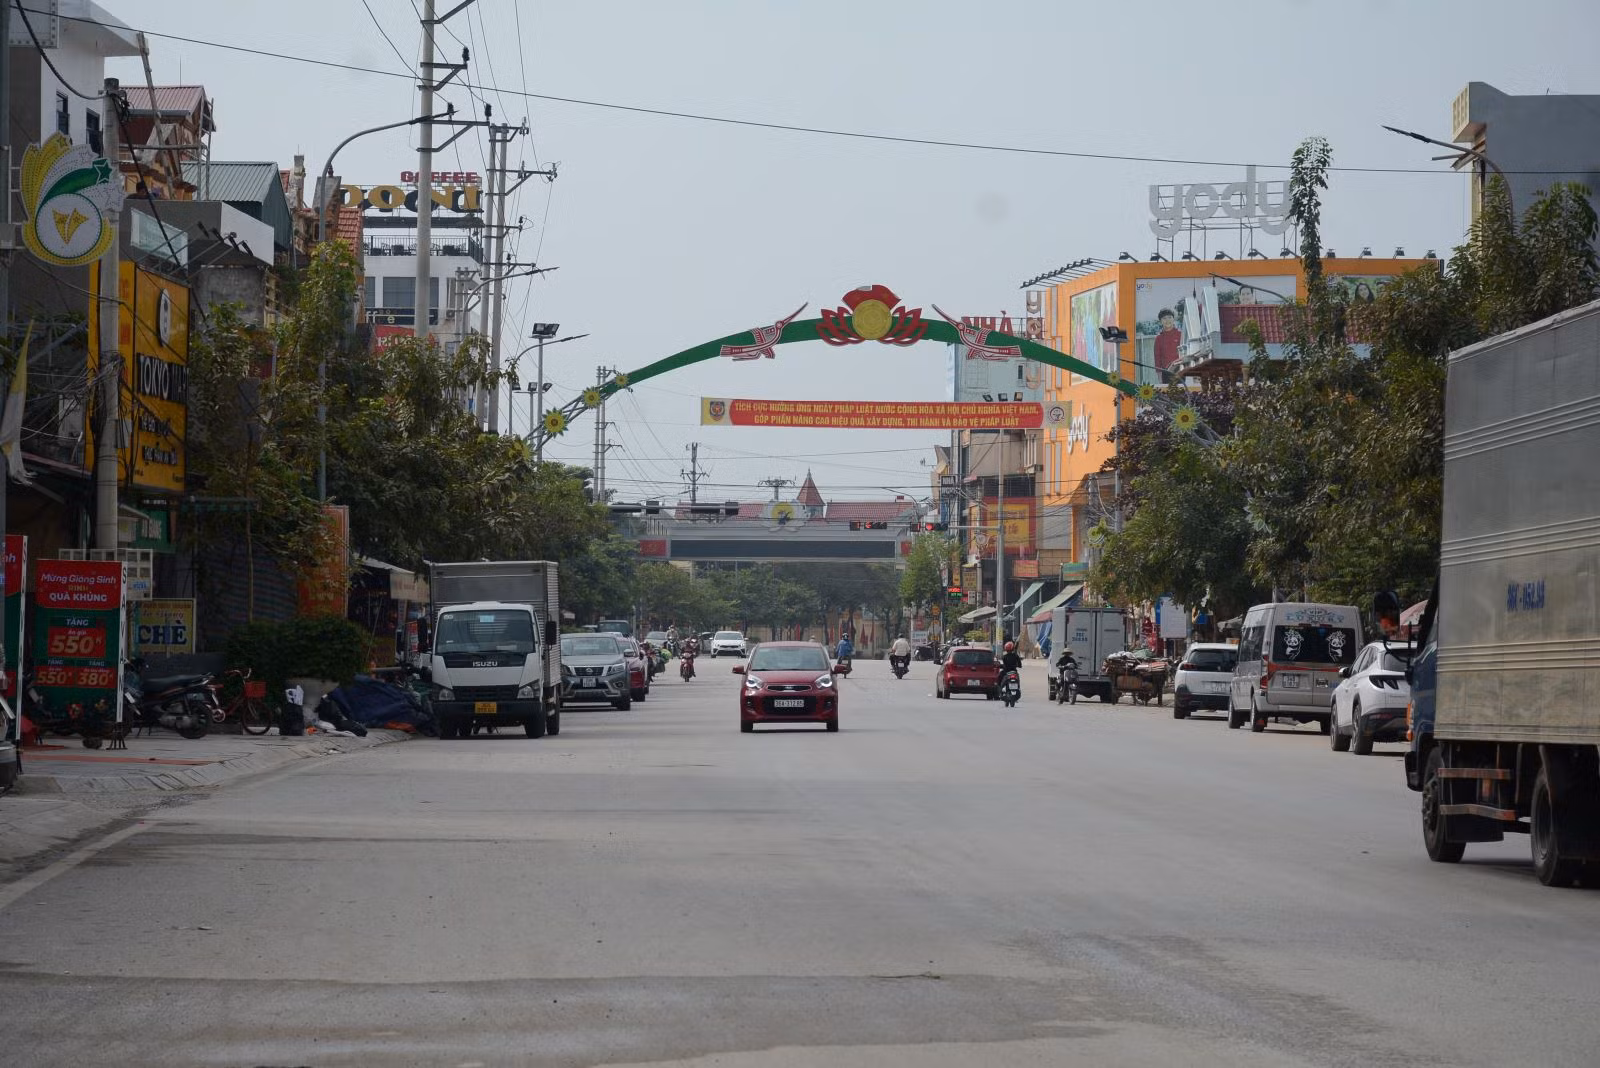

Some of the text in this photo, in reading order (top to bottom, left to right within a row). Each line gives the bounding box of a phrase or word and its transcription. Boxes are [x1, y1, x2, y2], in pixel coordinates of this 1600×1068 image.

[401, 171, 478, 182] CFFEE
[1149, 165, 1292, 238] yody
[140, 355, 168, 399] TOKYO
[735, 402, 751, 411] TÍCH
[834, 403, 854, 413] PHÁP
[856, 404, 873, 414] LUẬT
[897, 405, 917, 415] CỘNG
[936, 405, 945, 414] XÃ
[947, 405, 960, 415] HỘI
[961, 405, 976, 414] CHỦ
[977, 405, 1000, 414] NGHĨA
[1001, 405, 1017, 416] VIỆT
[754, 414, 769, 424] GÓP
[770, 414, 791, 425] PHẦN
[792, 415, 814, 425] NÂNG
[815, 416, 830, 425] CAO
[831, 416, 848, 427] HIỆU
[849, 416, 865, 426] QUẢ
[866, 416, 881, 426] XÂY
[907, 417, 918, 426] THI
[919, 417, 940, 426] HÀNH
[941, 417, 951, 426] VÀ
[953, 417, 968, 426] BẢO
[980, 417, 1000, 427] PHÁP
[1001, 417, 1019, 427] LUẬT
[41, 573, 117, 584] Mừng Giáng Sinh
[49, 591, 108, 602] QUÀ KHỦNG
[66, 617, 89, 626] TẶNG
[138, 620, 188, 645] CHÈ
